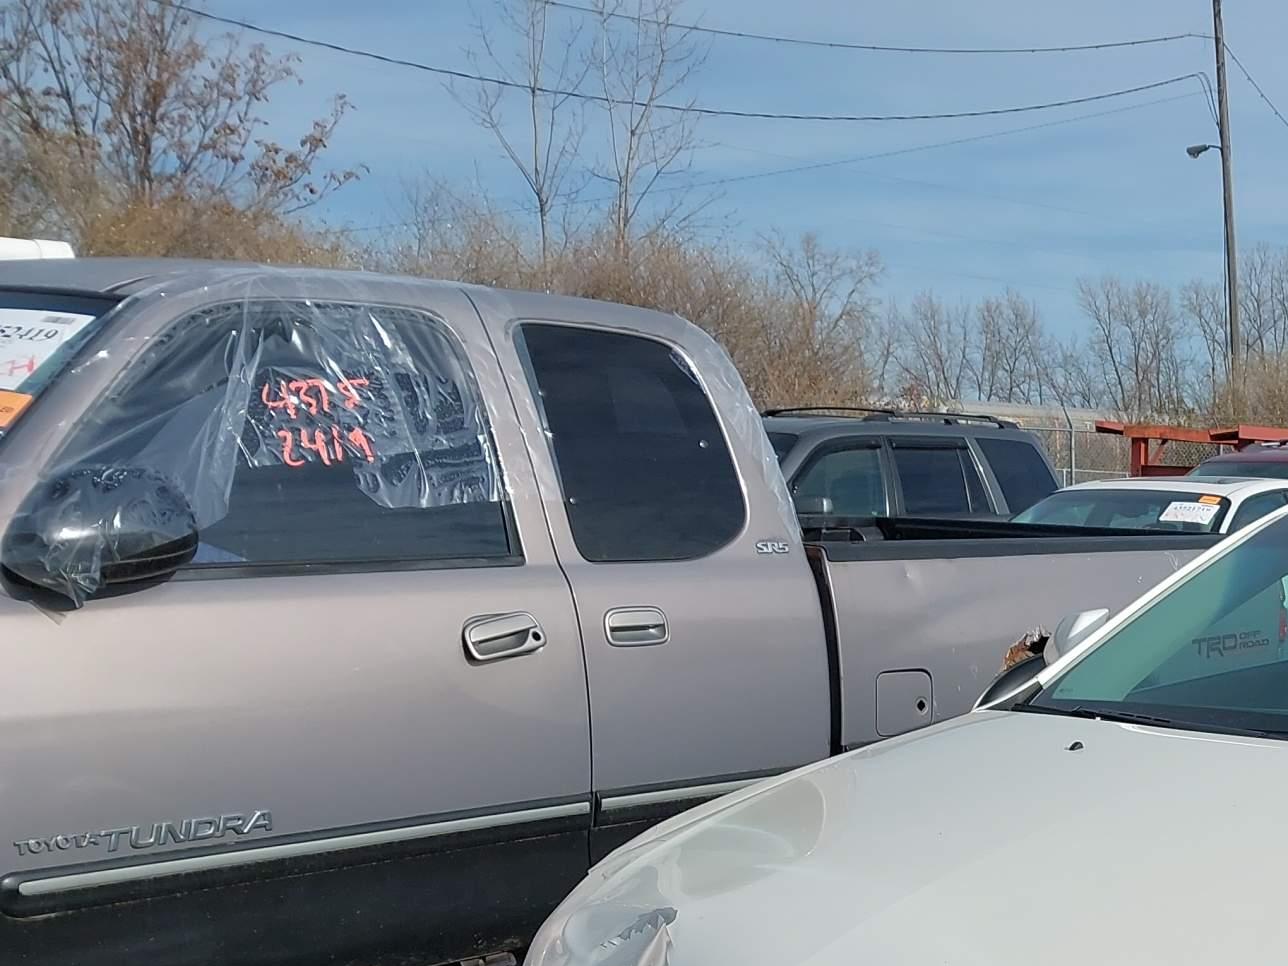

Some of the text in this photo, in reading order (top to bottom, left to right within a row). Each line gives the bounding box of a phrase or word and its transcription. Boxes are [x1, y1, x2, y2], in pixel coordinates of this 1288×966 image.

[277, 424, 375, 466] 2419
[756, 542, 789, 554] SR5
[13, 810, 273, 857] TOYOTA TUNDRA
